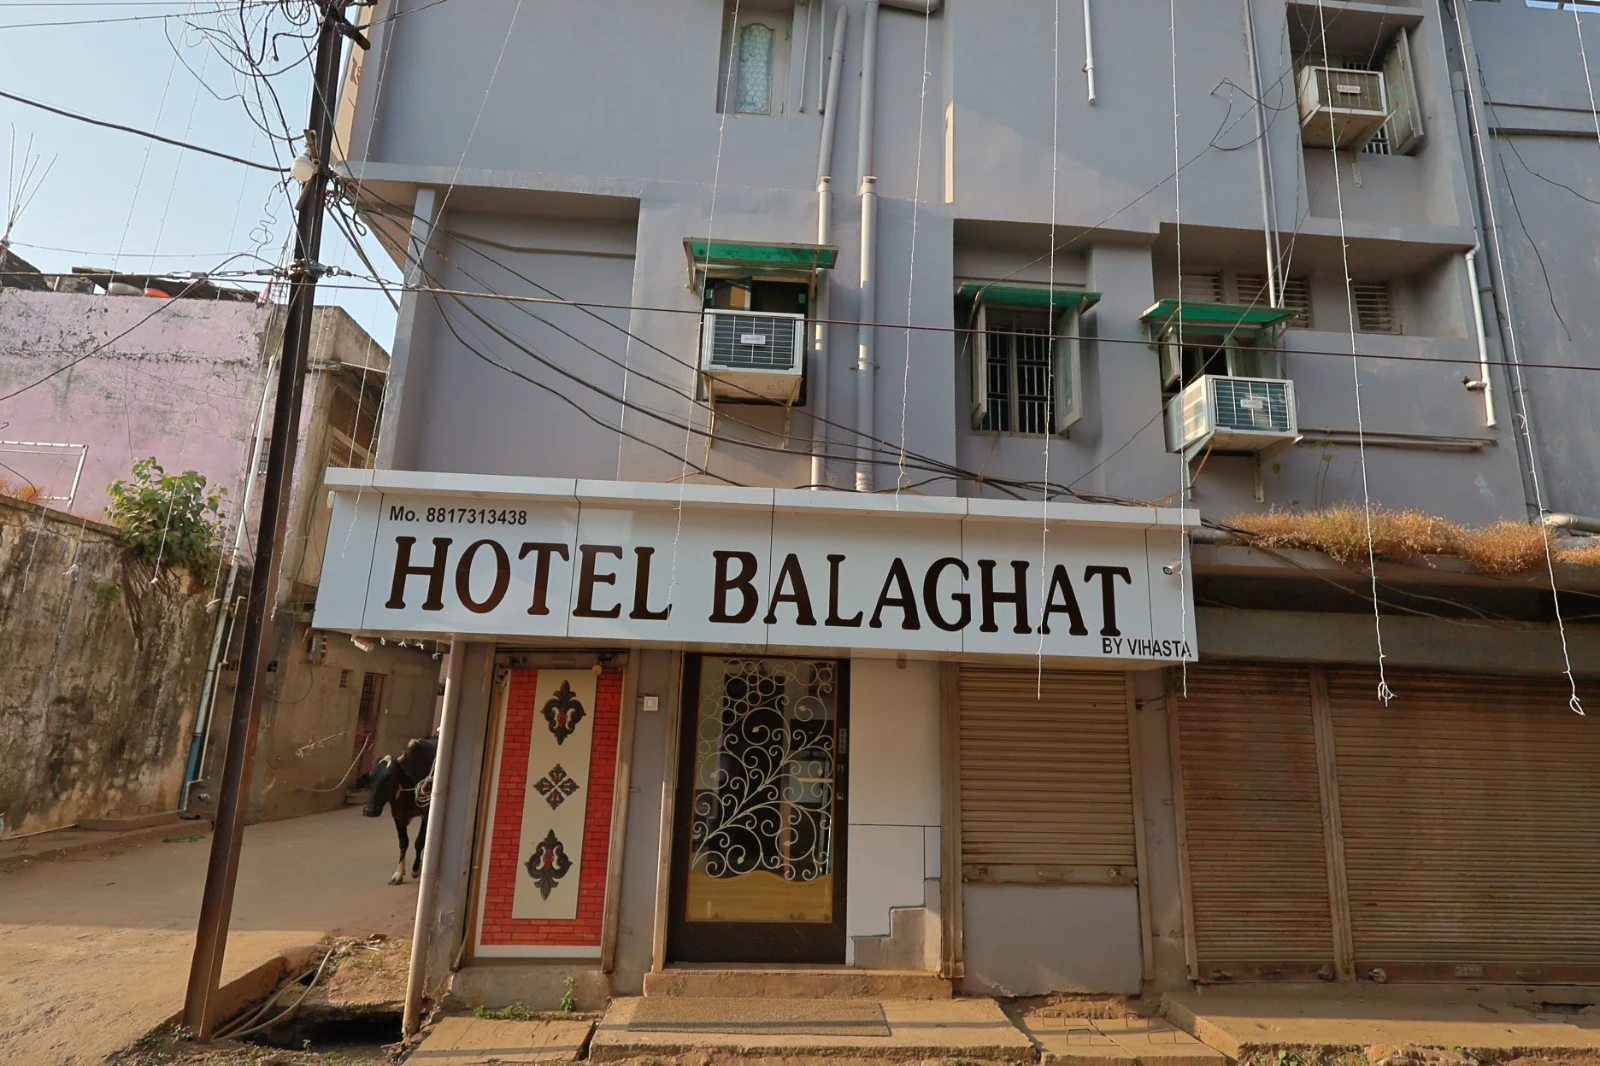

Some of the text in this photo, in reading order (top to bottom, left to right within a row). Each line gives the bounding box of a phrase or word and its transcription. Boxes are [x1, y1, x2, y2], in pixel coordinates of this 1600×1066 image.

[389, 506, 527, 525] Mo. 8817313438
[385, 536, 1132, 636] HOTEL BALAGHAT
[1102, 637, 1192, 657] BY VIHASTA
